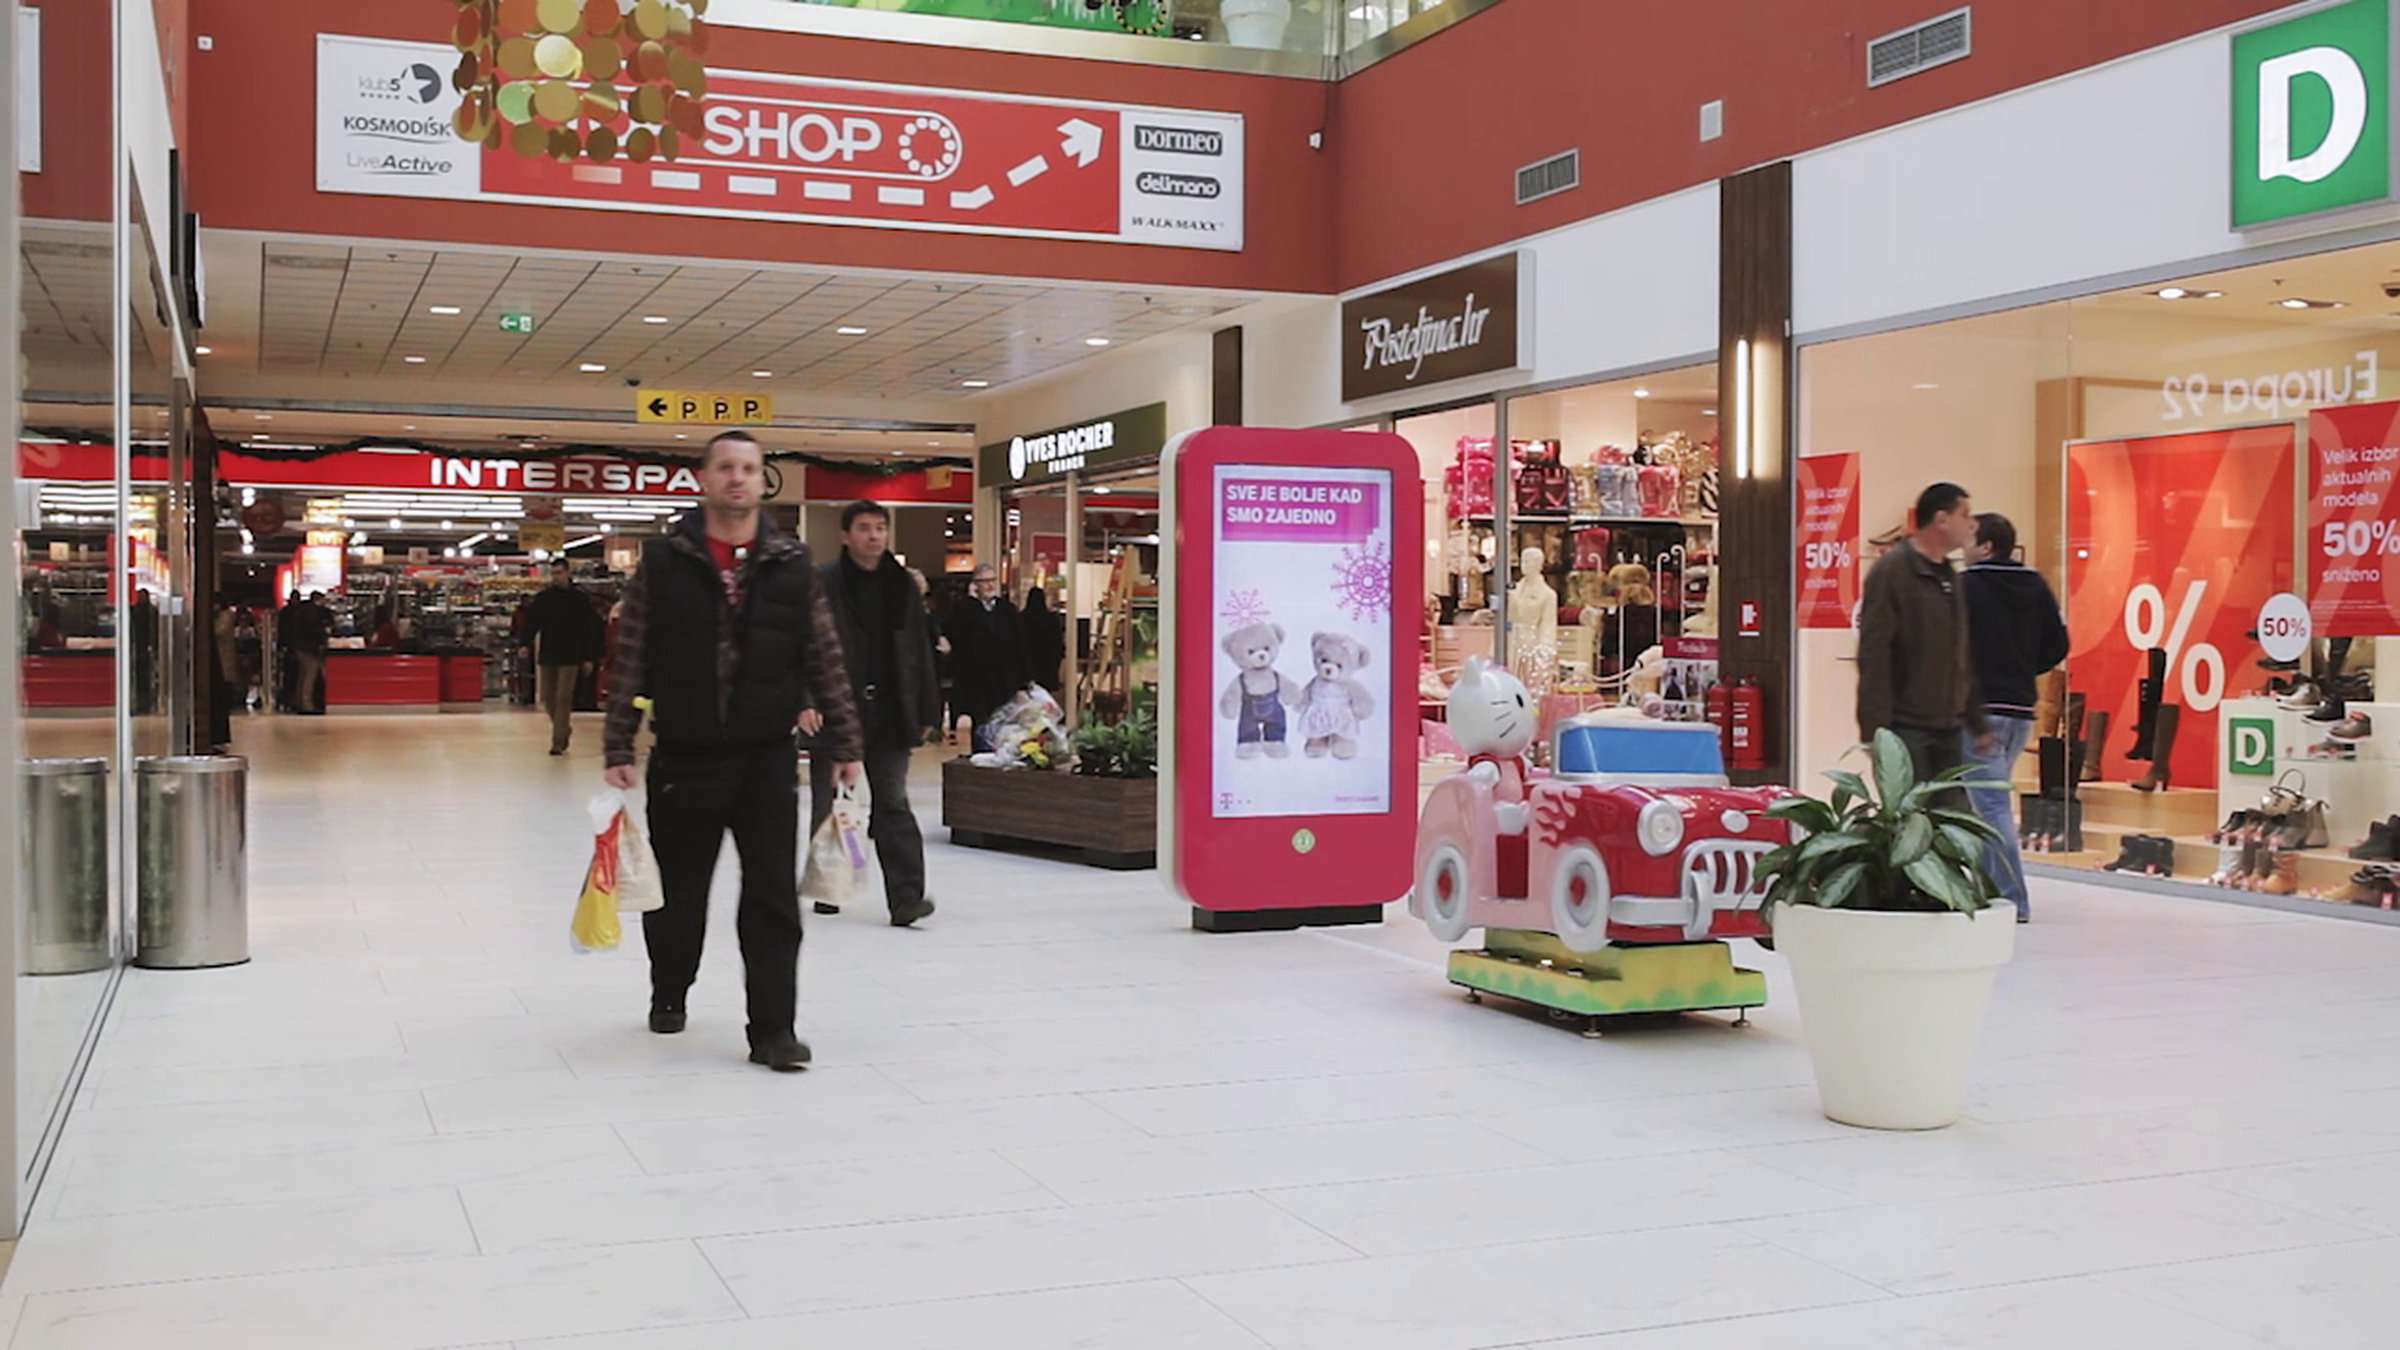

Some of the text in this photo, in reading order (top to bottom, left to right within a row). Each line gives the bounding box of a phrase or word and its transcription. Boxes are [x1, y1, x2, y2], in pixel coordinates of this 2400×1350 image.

[2258, 45, 2368, 183] D
[704, 105, 882, 162] SHOP
[1139, 174, 1218, 196] delimano
[1025, 421, 1115, 464] YVES ROCHER
[2322, 448, 2359, 464] Velik
[431, 457, 701, 491] INTERSPA
[1226, 485, 1362, 504] SVE JE BOLJE KAD
[2322, 491, 2379, 507] modela
[1226, 507, 1336, 525] SMO ZAJEDNO
[2323, 519, 2400, 558] 50%
[1805, 541, 1851, 569] 50%
[2262, 617, 2307, 638] 50%
[2235, 726, 2267, 766] D
